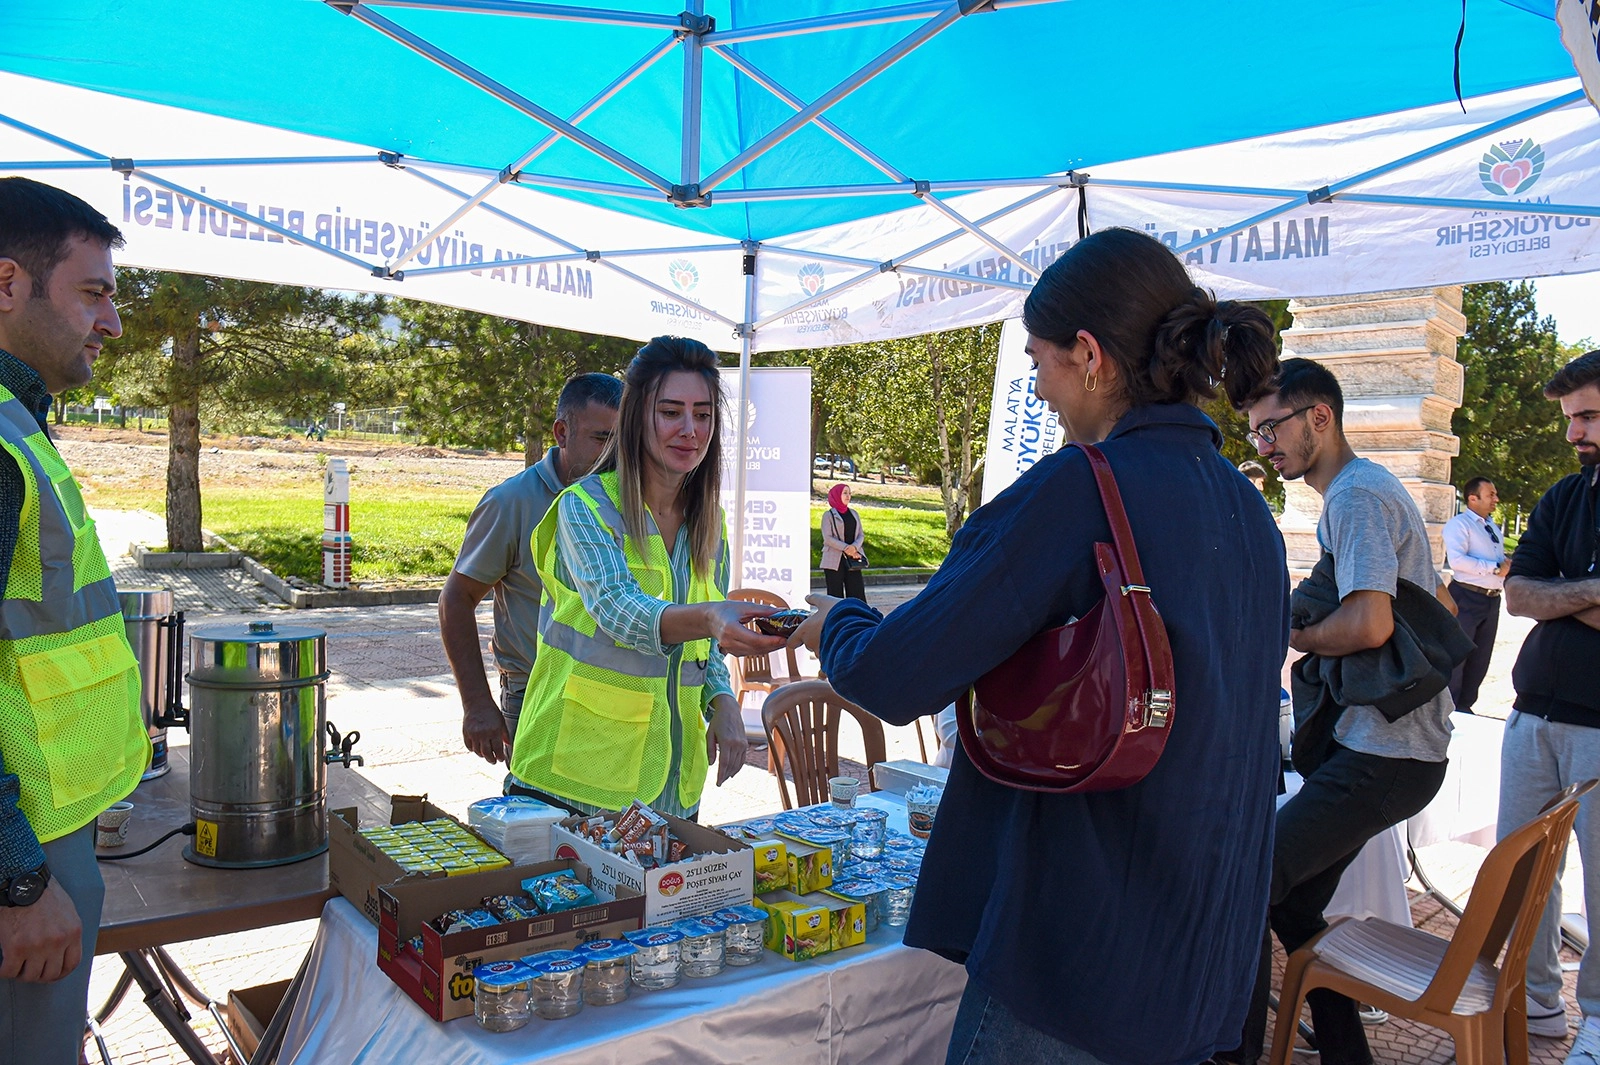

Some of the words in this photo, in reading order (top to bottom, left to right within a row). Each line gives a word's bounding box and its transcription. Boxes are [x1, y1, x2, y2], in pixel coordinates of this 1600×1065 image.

[1002, 377, 1024, 452] MALATYA
[703, 862, 728, 874] SÜZEN
[686, 878, 707, 889] POŞET
[708, 873, 728, 884] SİYAH
[728, 870, 743, 880] ÇAY
